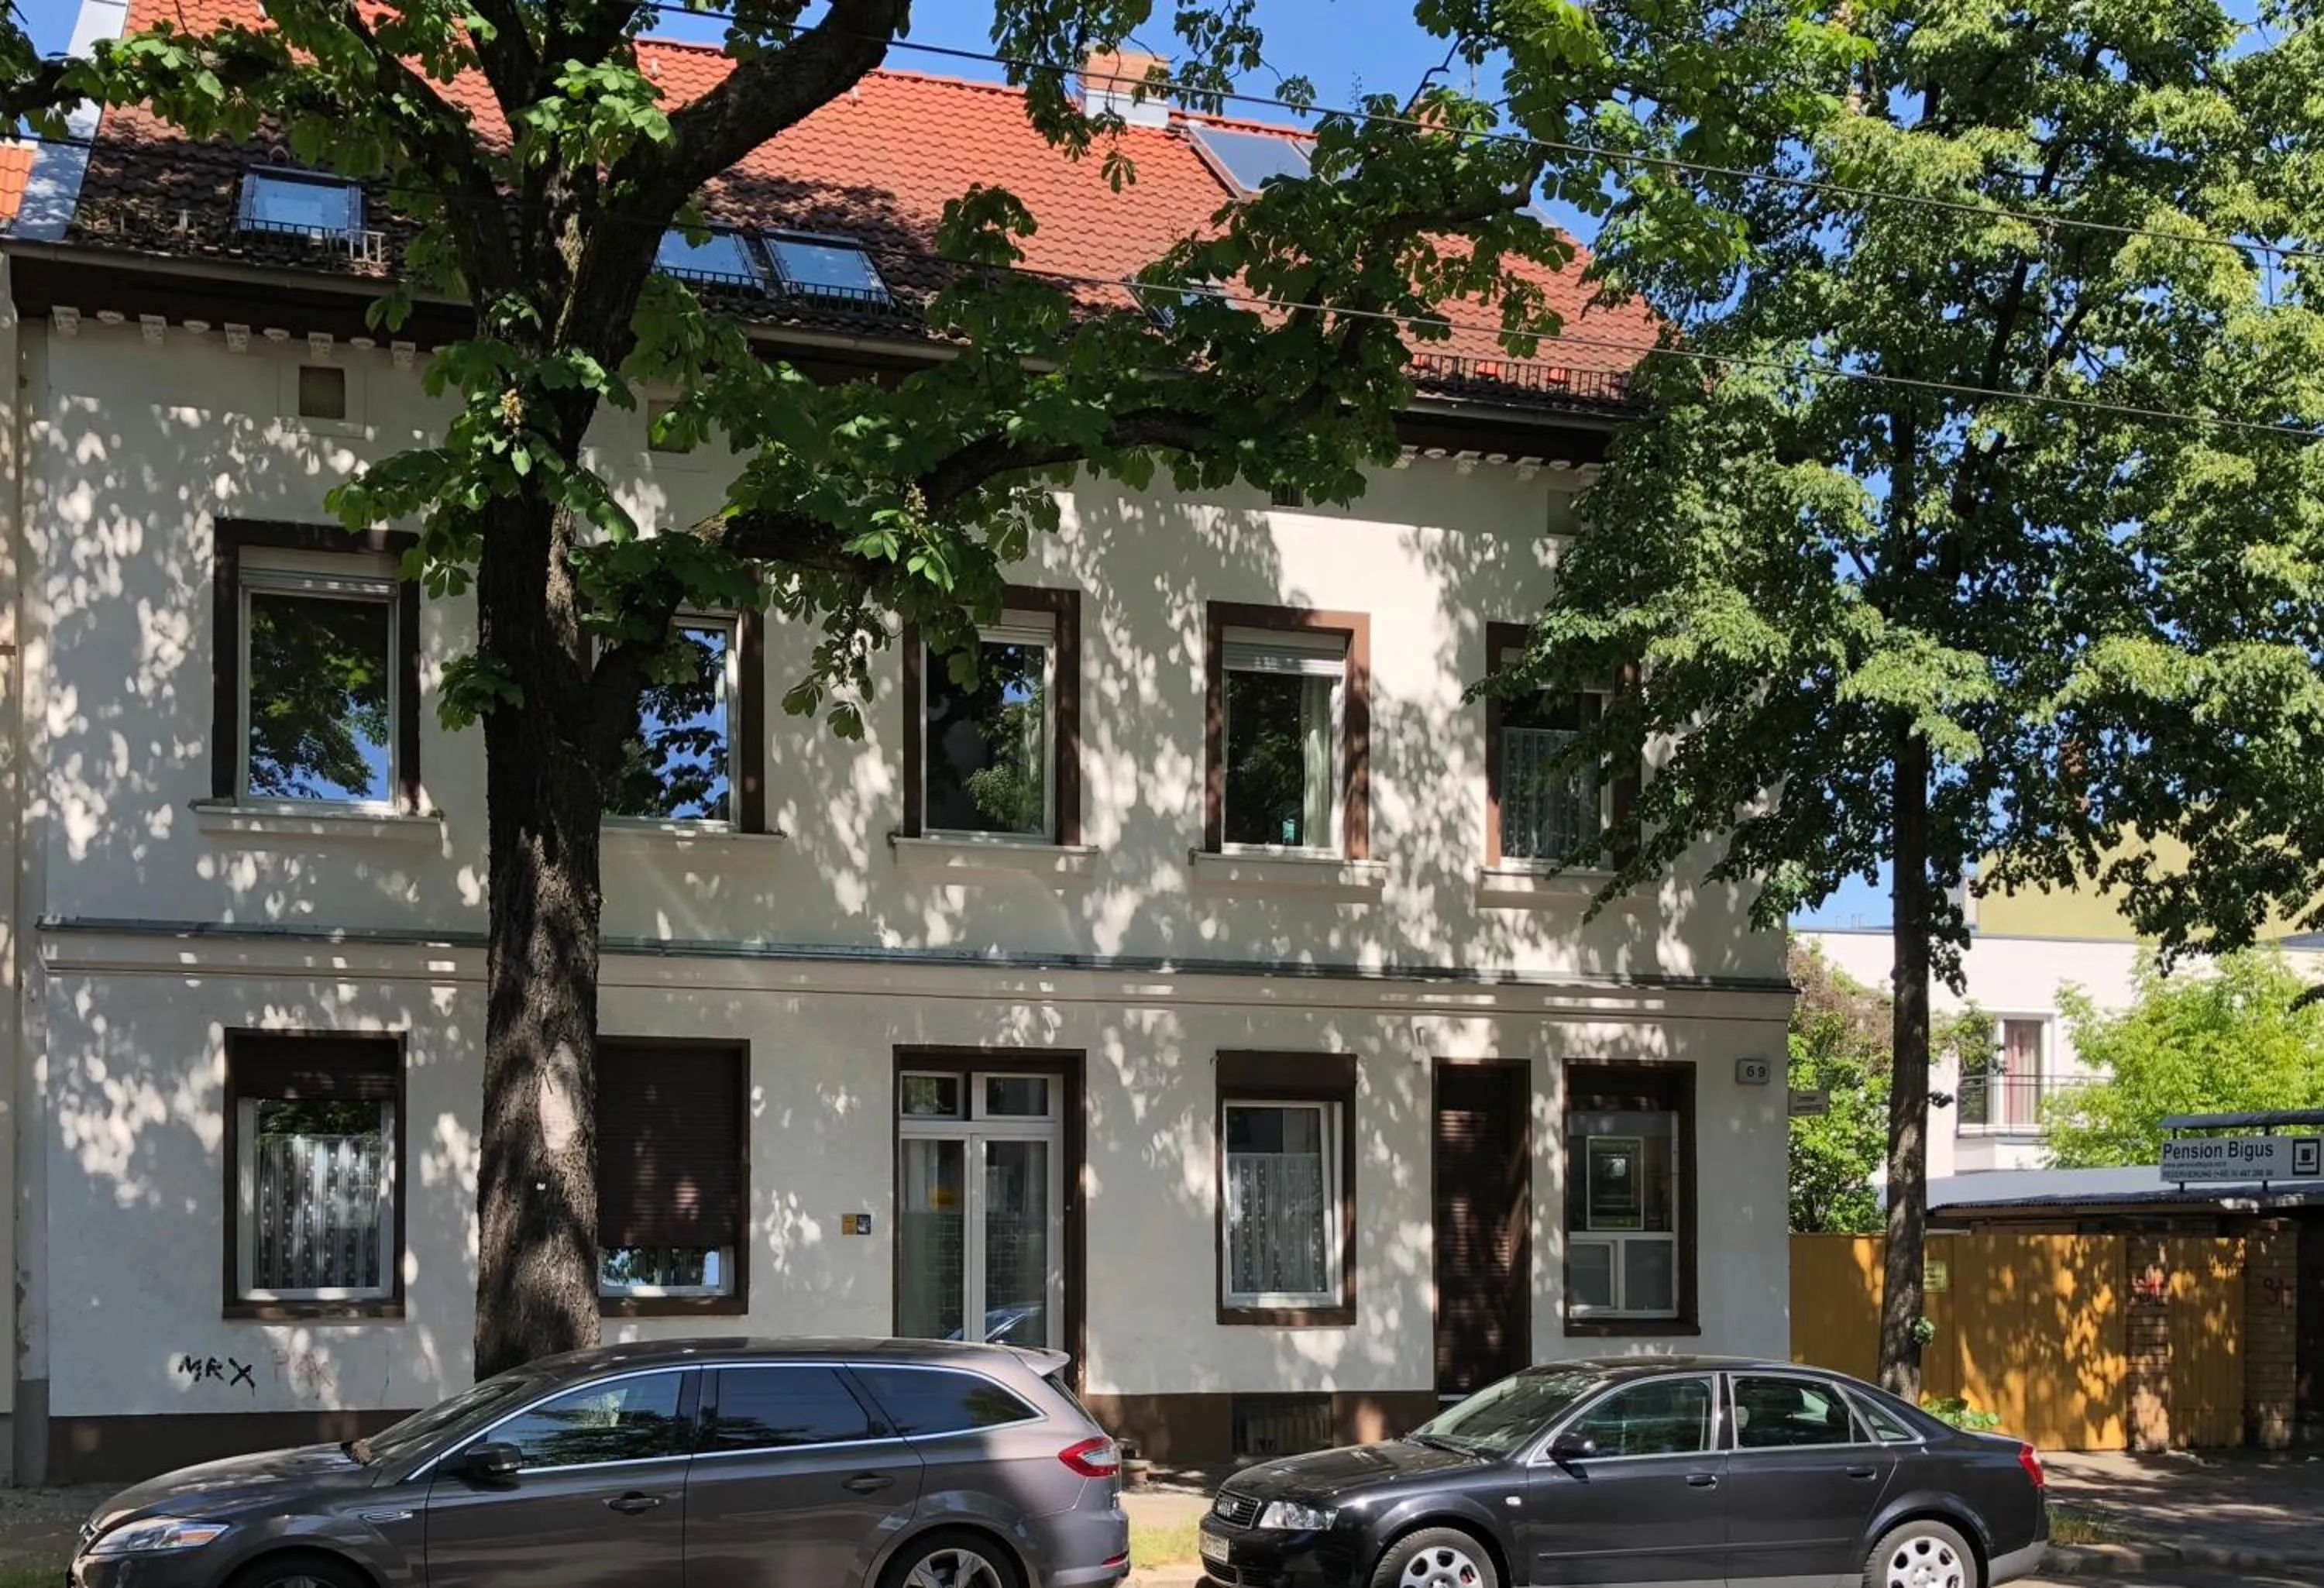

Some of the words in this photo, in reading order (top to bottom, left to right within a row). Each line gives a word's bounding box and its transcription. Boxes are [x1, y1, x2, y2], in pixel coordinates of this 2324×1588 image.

[1746, 1065, 1765, 1078] 69
[2163, 1142, 2223, 1160] Pension
[2228, 1141, 2274, 1161] Bigus
